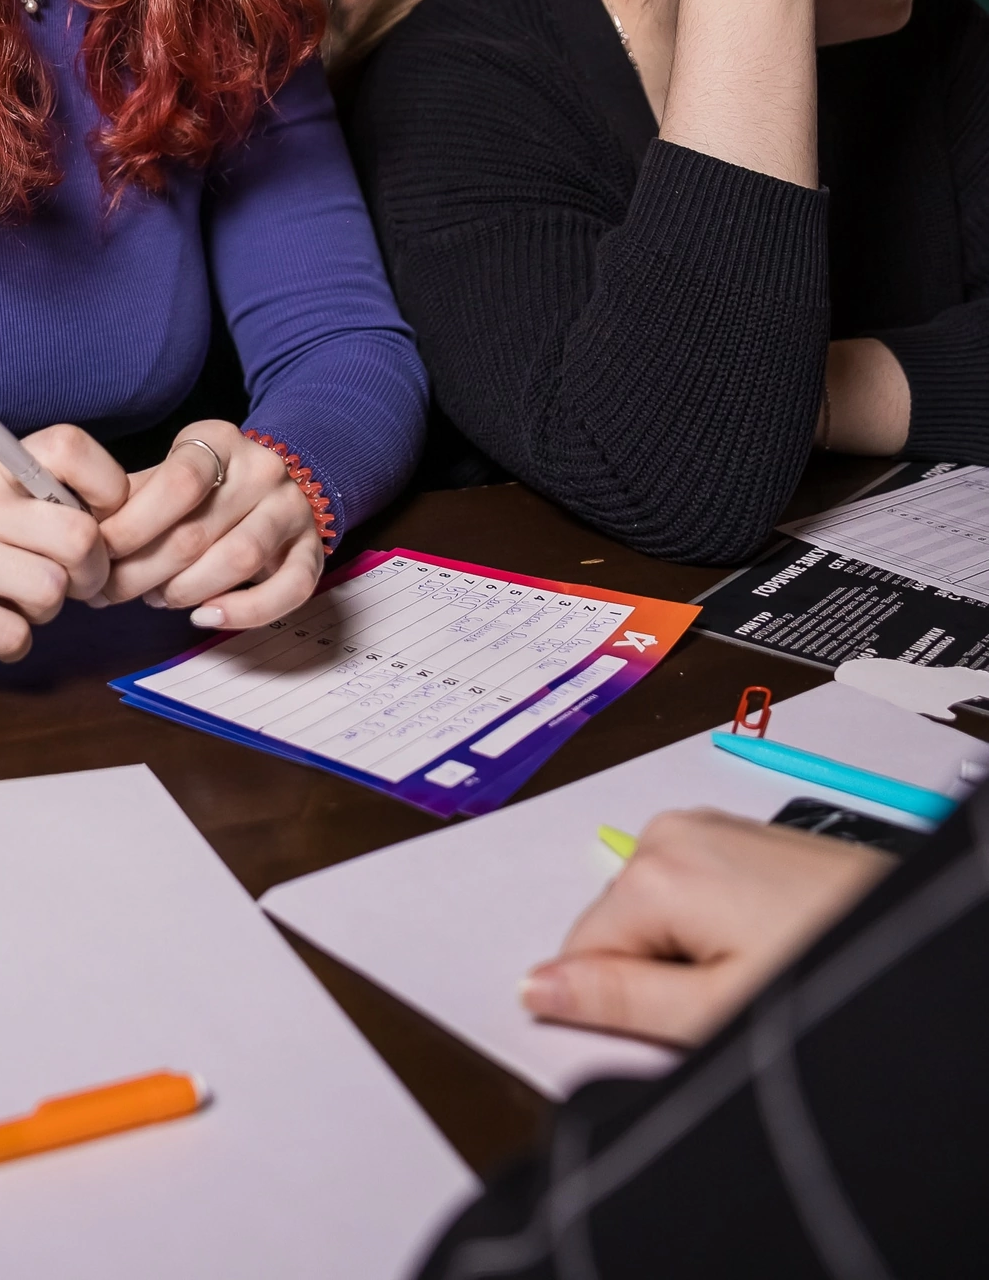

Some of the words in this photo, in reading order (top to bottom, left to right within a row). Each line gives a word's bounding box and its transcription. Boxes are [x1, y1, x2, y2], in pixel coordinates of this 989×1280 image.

[391, 559, 408, 567] 10
[752, 561, 806, 597] ГОРЯЧИЕ
[798, 547, 830, 569] ЗАКУ
[431, 585, 474, 604] BTS
[268, 620, 287, 630] 20
[549, 610, 590, 630] Anna
[580, 616, 620, 634] Bad
[294, 629, 310, 638] 19
[316, 637, 334, 646] 18
[343, 645, 358, 654] 17
[365, 652, 383, 661] 16
[390, 660, 408, 670] 15
[416, 668, 434, 678] 14
[441, 677, 460, 686] 13
[468, 685, 486, 695] 12
[496, 694, 513, 703] 11
